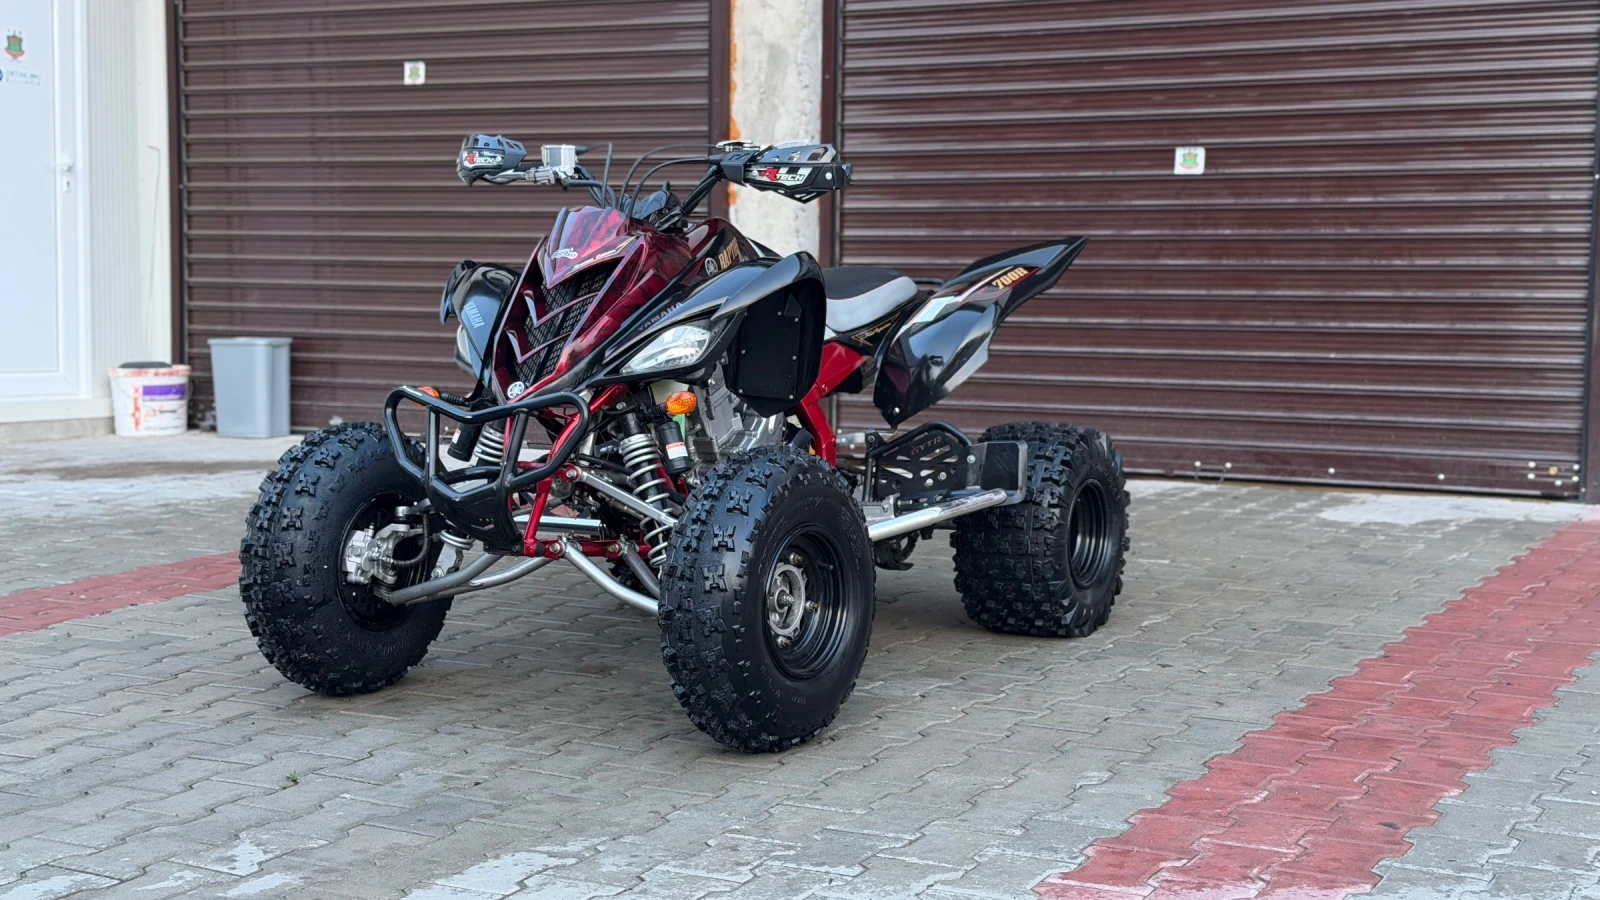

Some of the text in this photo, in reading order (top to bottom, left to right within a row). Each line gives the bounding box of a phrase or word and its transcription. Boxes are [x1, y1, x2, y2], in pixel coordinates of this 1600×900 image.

[991, 267, 1028, 290] 700R
[463, 300, 485, 329] YAMAHA
[638, 301, 684, 331] YAMAHA
[911, 436, 943, 455] GYTR
